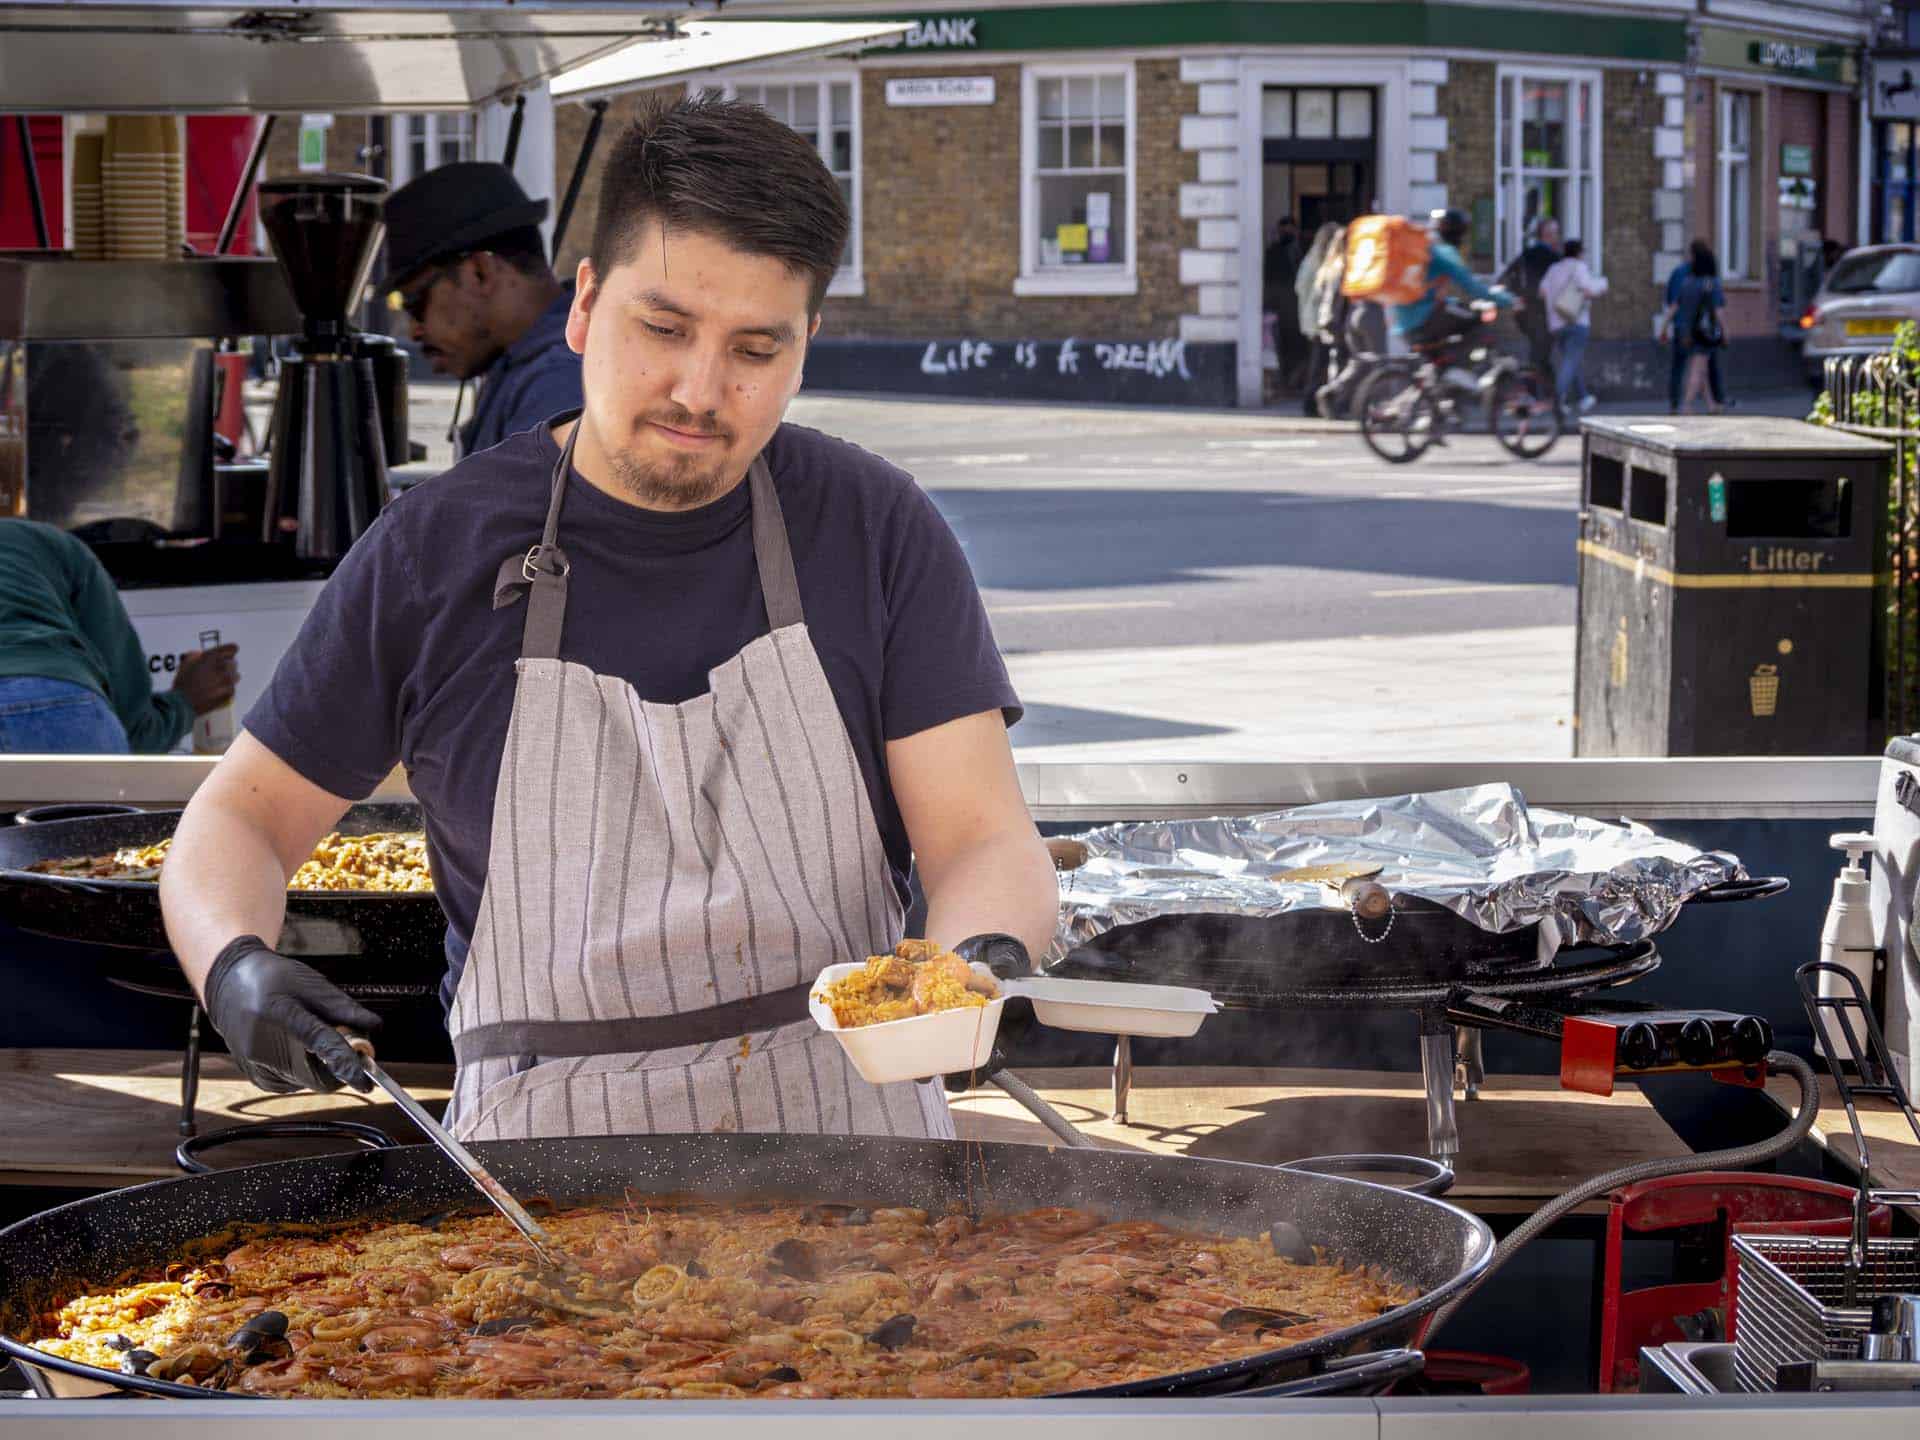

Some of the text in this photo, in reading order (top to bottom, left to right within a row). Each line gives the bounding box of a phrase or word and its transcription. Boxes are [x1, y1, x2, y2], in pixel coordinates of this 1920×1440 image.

[905, 17, 977, 47] BANK
[1015, 340, 1037, 368] IS
[1058, 337, 1080, 373] A
[1749, 546, 1825, 571] Litter
